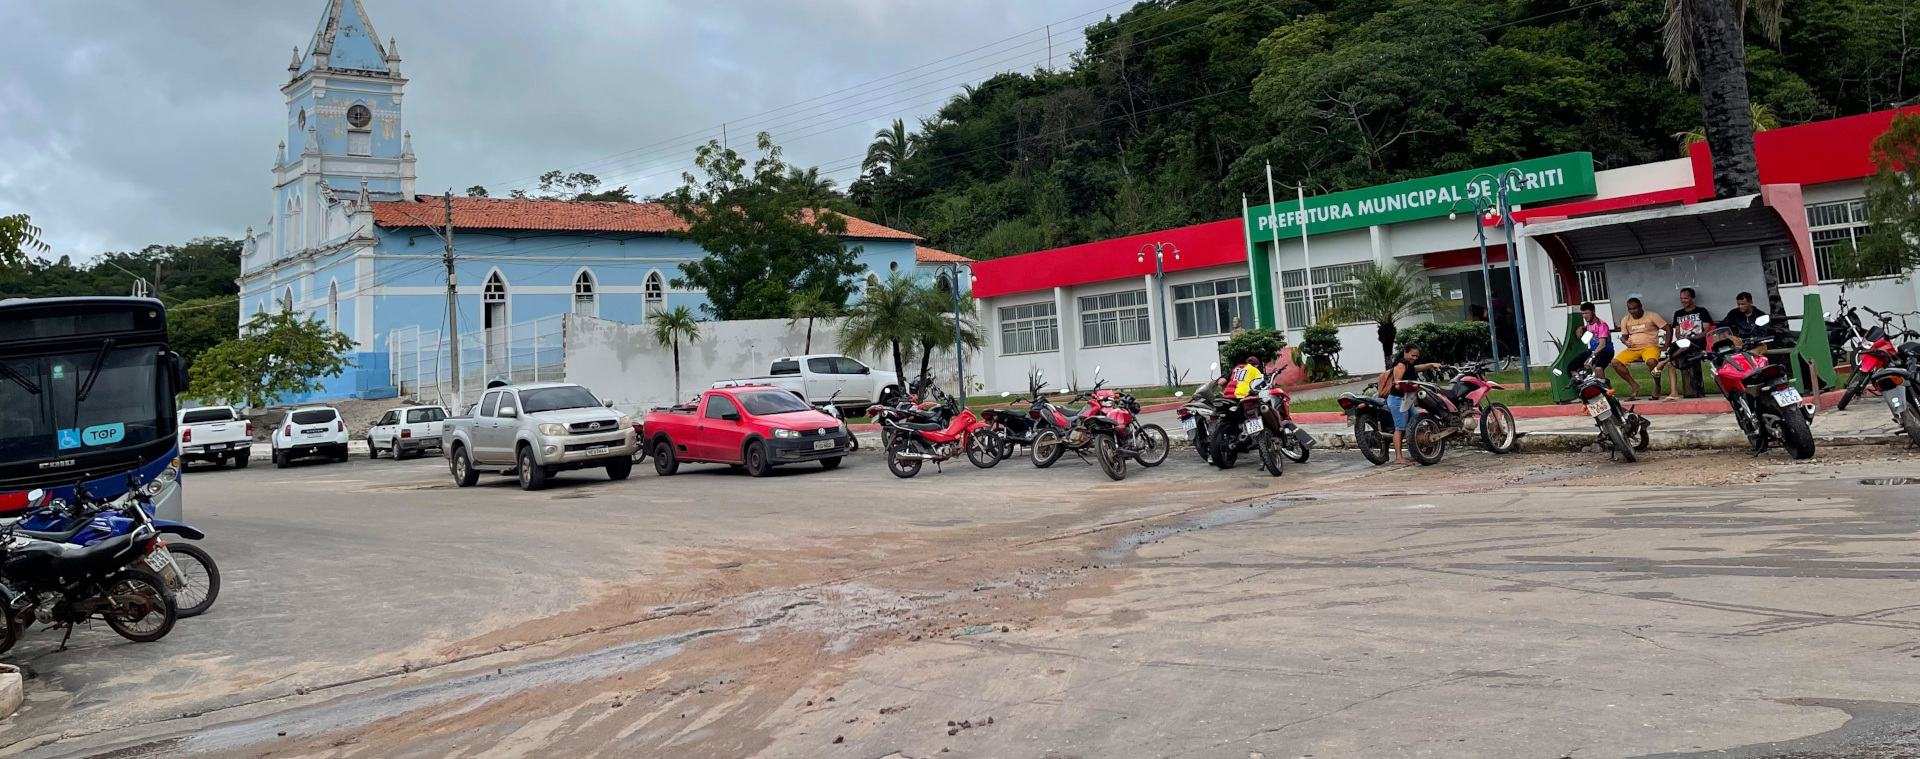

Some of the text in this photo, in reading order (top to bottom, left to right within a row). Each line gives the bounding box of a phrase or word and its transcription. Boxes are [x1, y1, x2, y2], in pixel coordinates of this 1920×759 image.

[1258, 202, 1354, 231] PREFEITURA
[1358, 185, 1462, 216] MUNICIPAL
[1466, 180, 1492, 199] DE
[1233, 368, 1248, 381] 10
[89, 428, 117, 441] TOP
